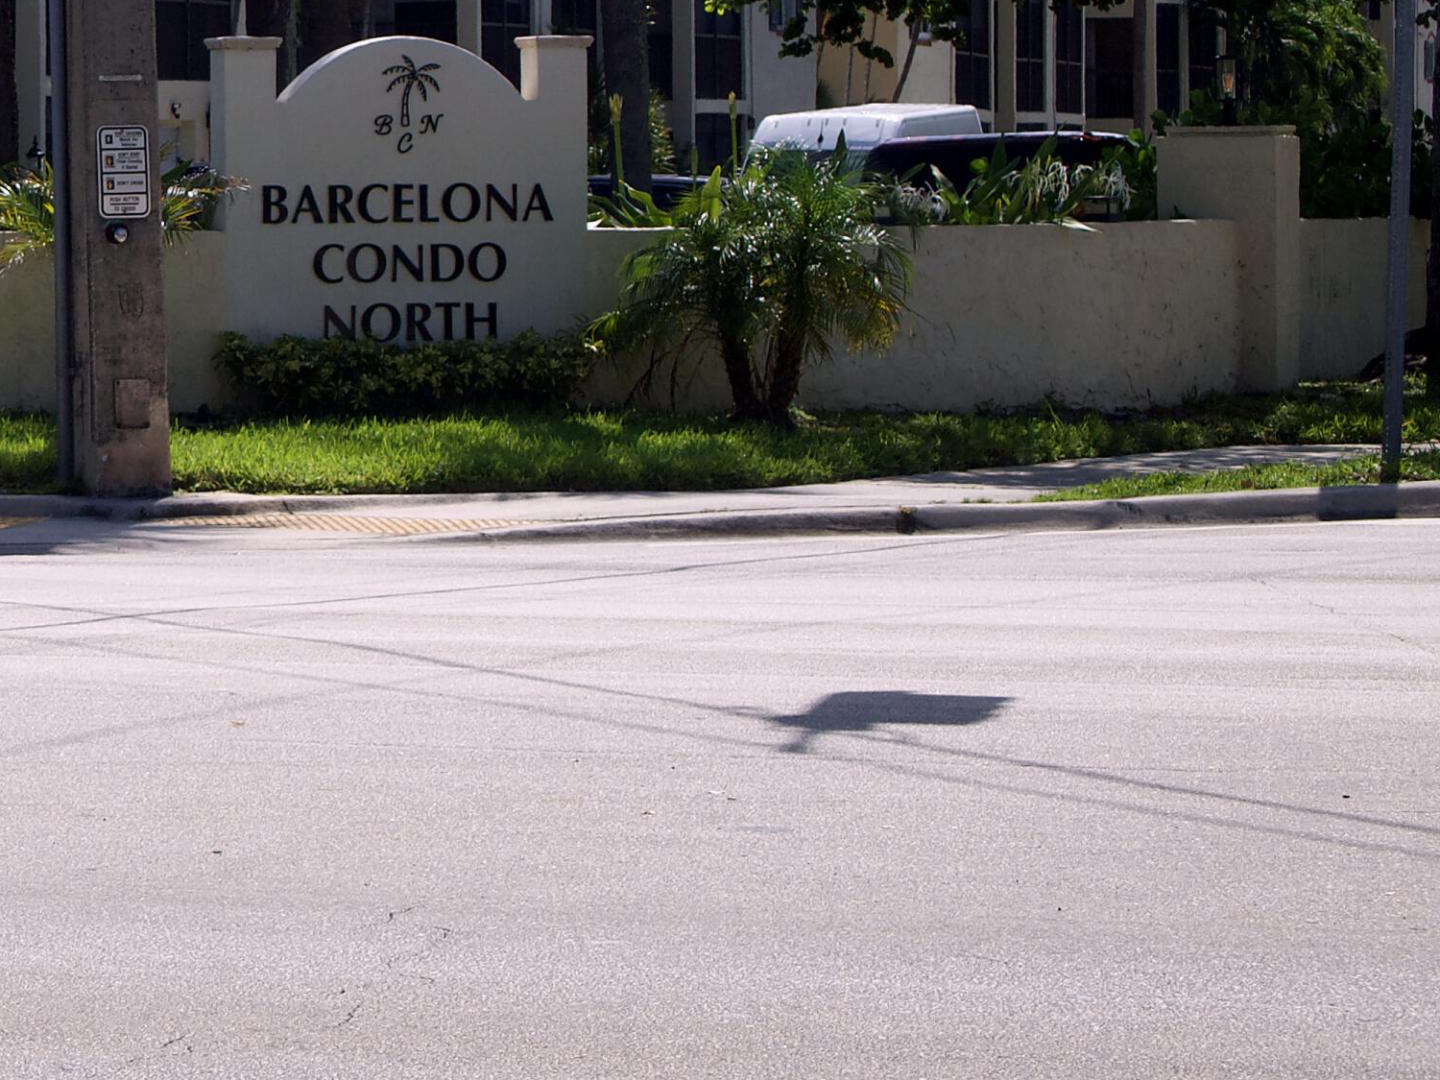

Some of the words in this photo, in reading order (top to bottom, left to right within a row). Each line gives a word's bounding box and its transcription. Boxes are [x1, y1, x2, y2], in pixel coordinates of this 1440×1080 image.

[374, 114, 394, 136] B
[418, 113, 444, 135] N
[396, 132, 414, 154] C
[261, 182, 554, 224] BARCELONA
[313, 242, 508, 284] CONDO
[323, 302, 498, 342] NORTH
